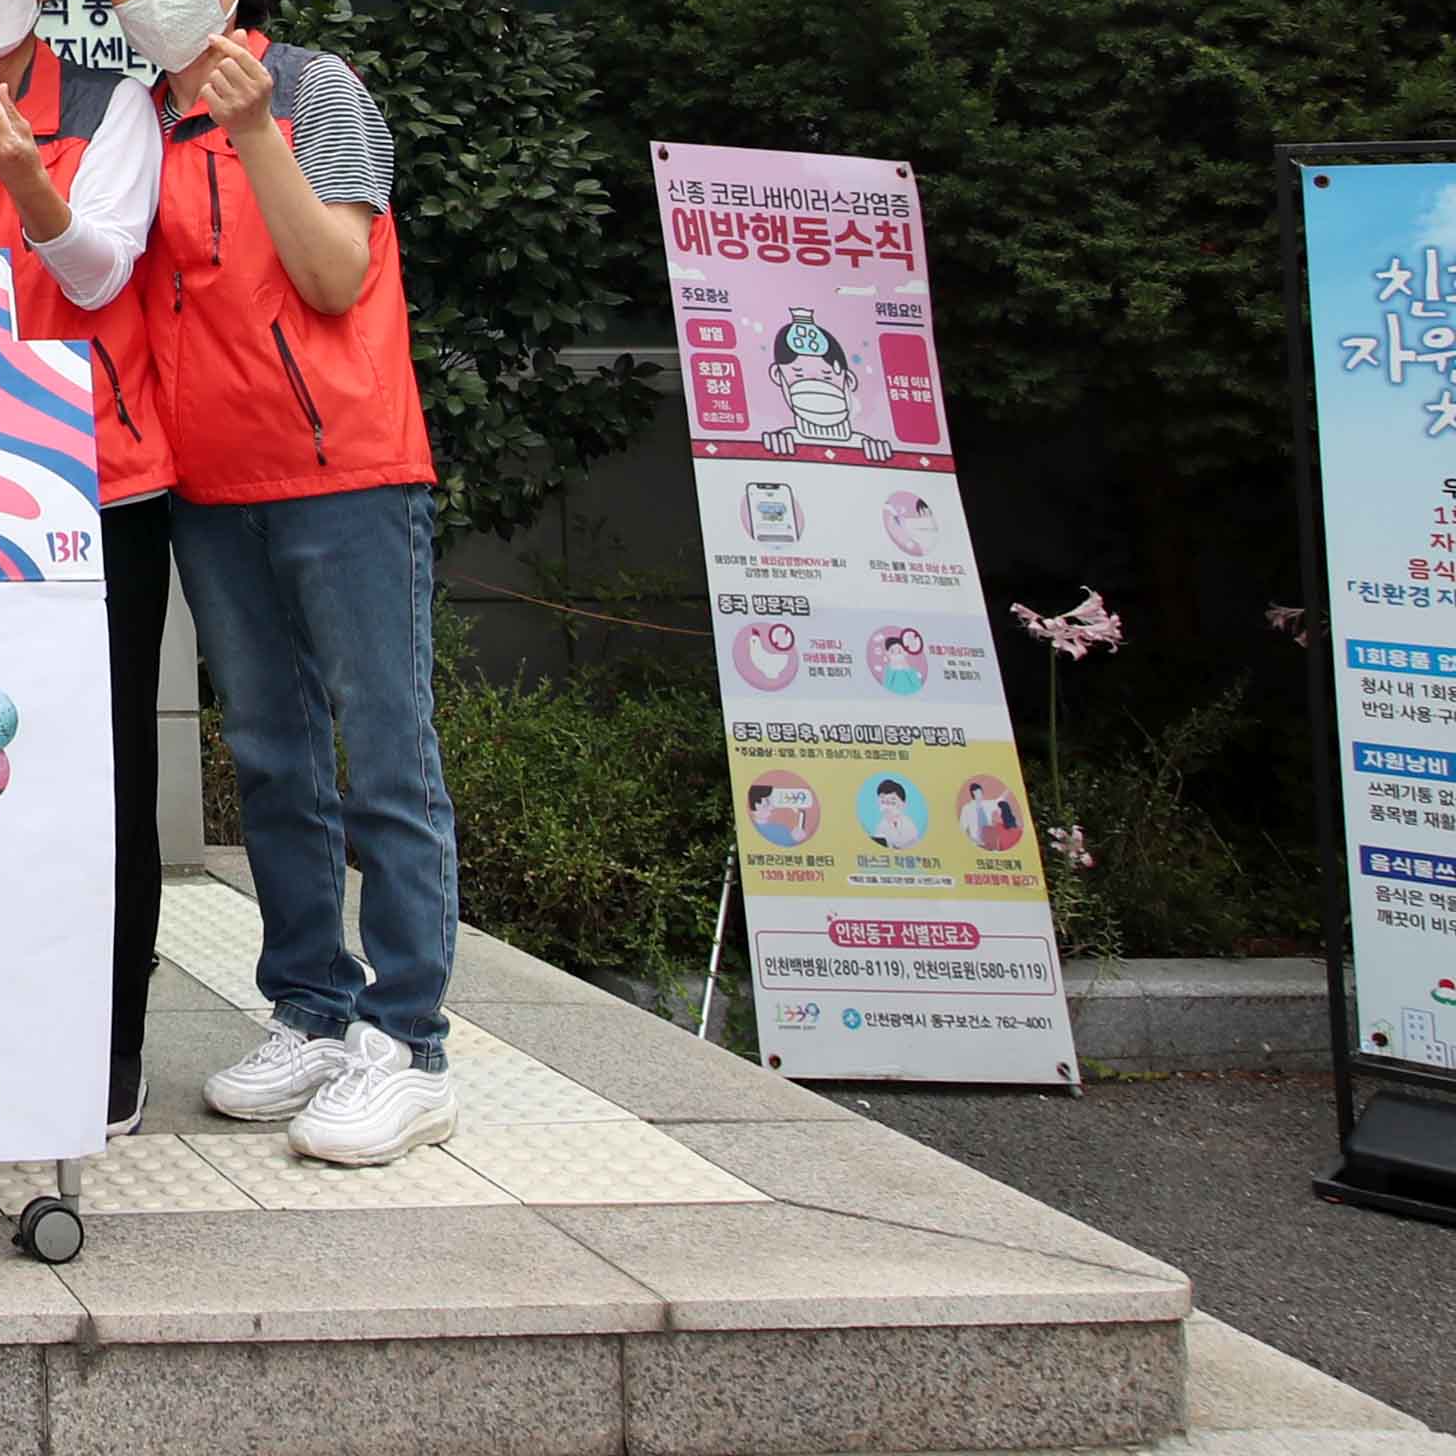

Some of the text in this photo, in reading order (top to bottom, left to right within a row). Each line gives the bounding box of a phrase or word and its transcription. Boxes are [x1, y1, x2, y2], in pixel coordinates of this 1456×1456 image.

[668, 178, 910, 218] 신종 코로나바이러스감염증
[671, 206, 915, 272] 예방행동수칙
[1375, 248, 1456, 317] 친
[681, 286, 730, 304] 주요증상
[875, 301, 923, 319] 위험요인
[46, 531, 92, 563] BR
[1408, 557, 1456, 583] 음식
[718, 594, 811, 617] 중국 방문객은
[1361, 676, 1456, 703] 청사 내 1회용
[733, 722, 762, 742] 중국
[766, 722, 796, 743] 방문
[820, 724, 853, 744] 14일
[854, 725, 882, 745] 이내
[922, 726, 950, 746] 발생
[951, 727, 967, 747] 시
[1362, 749, 1449, 776] 자원낭비
[1368, 781, 1433, 804] 쓰레기통
[1424, 811, 1456, 831] 재활
[1369, 853, 1456, 882] 음식물쓰
[1376, 884, 1425, 908] 음식은
[1376, 908, 1426, 931] 깨끗이
[836, 923, 974, 947] 인천동구 선별진료소
[913, 959, 1048, 982] 인천의료원(580-6119)
[864, 1011, 1054, 1031] 인천광역시 동구보건소 762-4001
